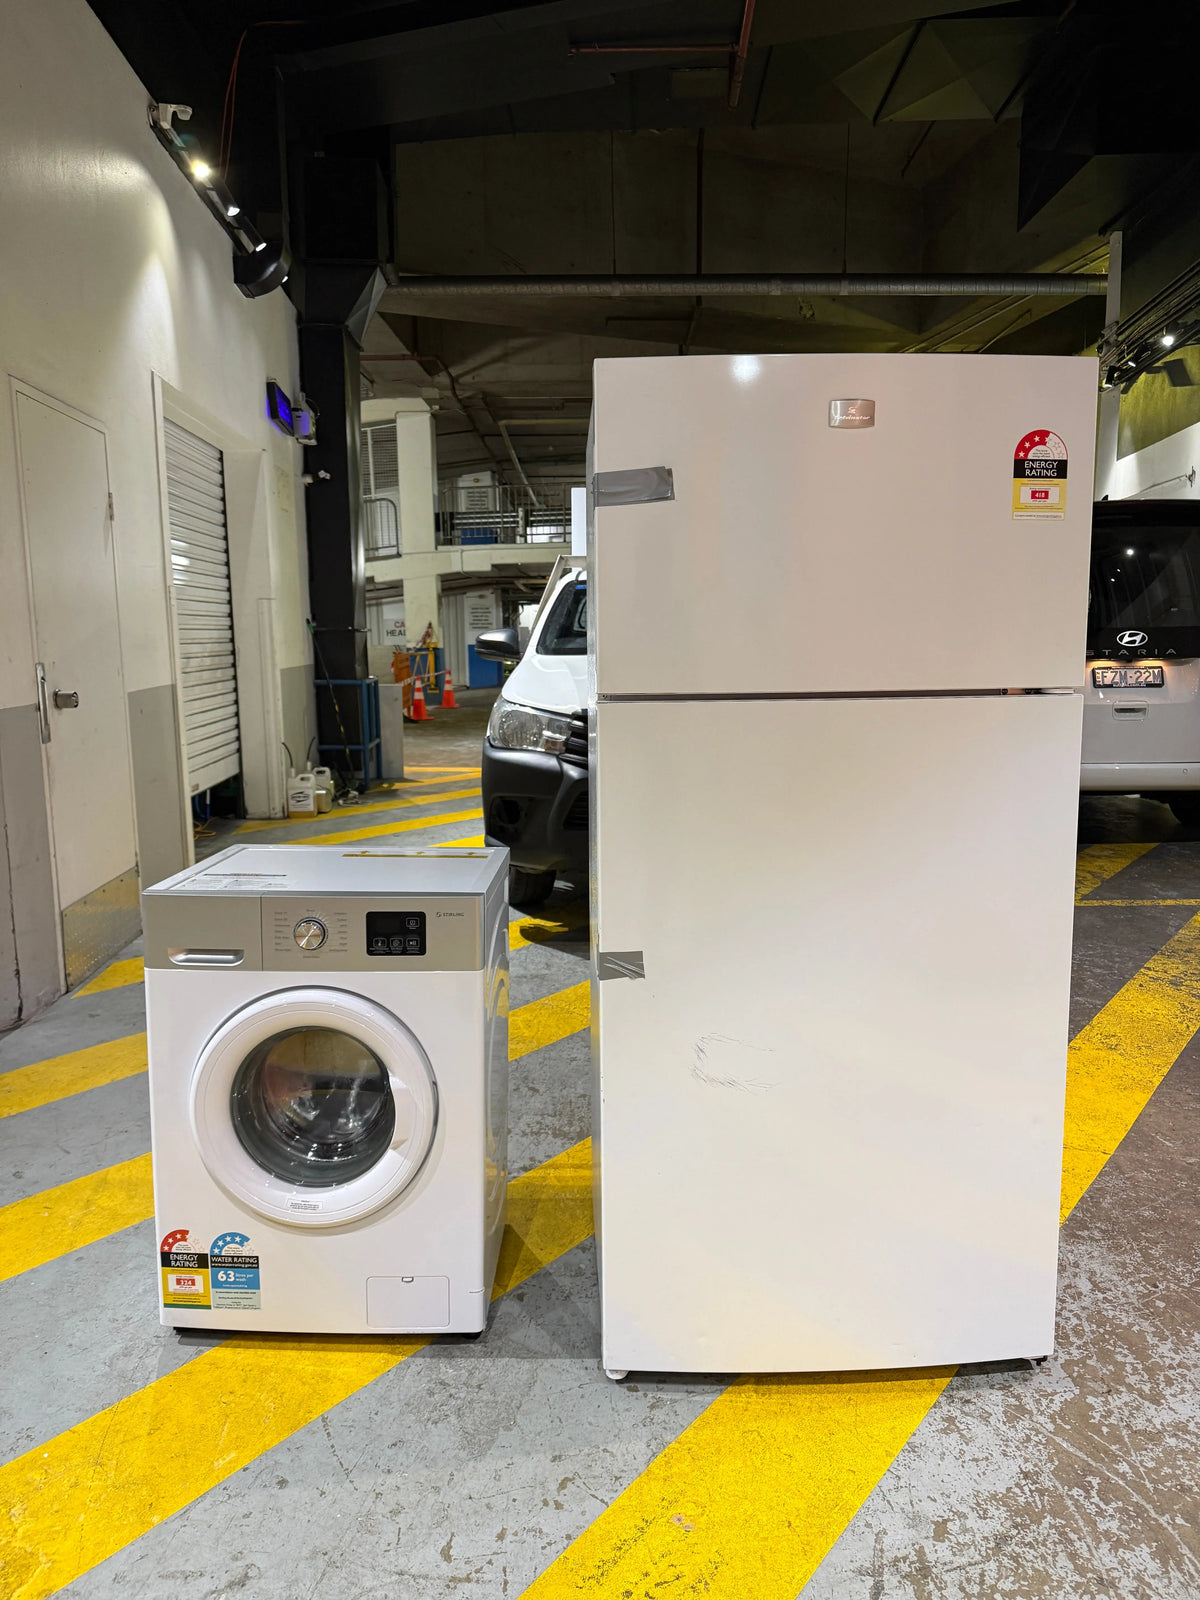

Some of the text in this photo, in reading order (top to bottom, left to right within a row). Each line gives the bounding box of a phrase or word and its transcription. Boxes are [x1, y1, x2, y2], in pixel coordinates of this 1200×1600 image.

[1024, 461, 1058, 469] ENERGY
[1025, 469, 1057, 477] RATING
[170, 1254, 198, 1262] ENERGY
[217, 1270, 235, 1282] 63
